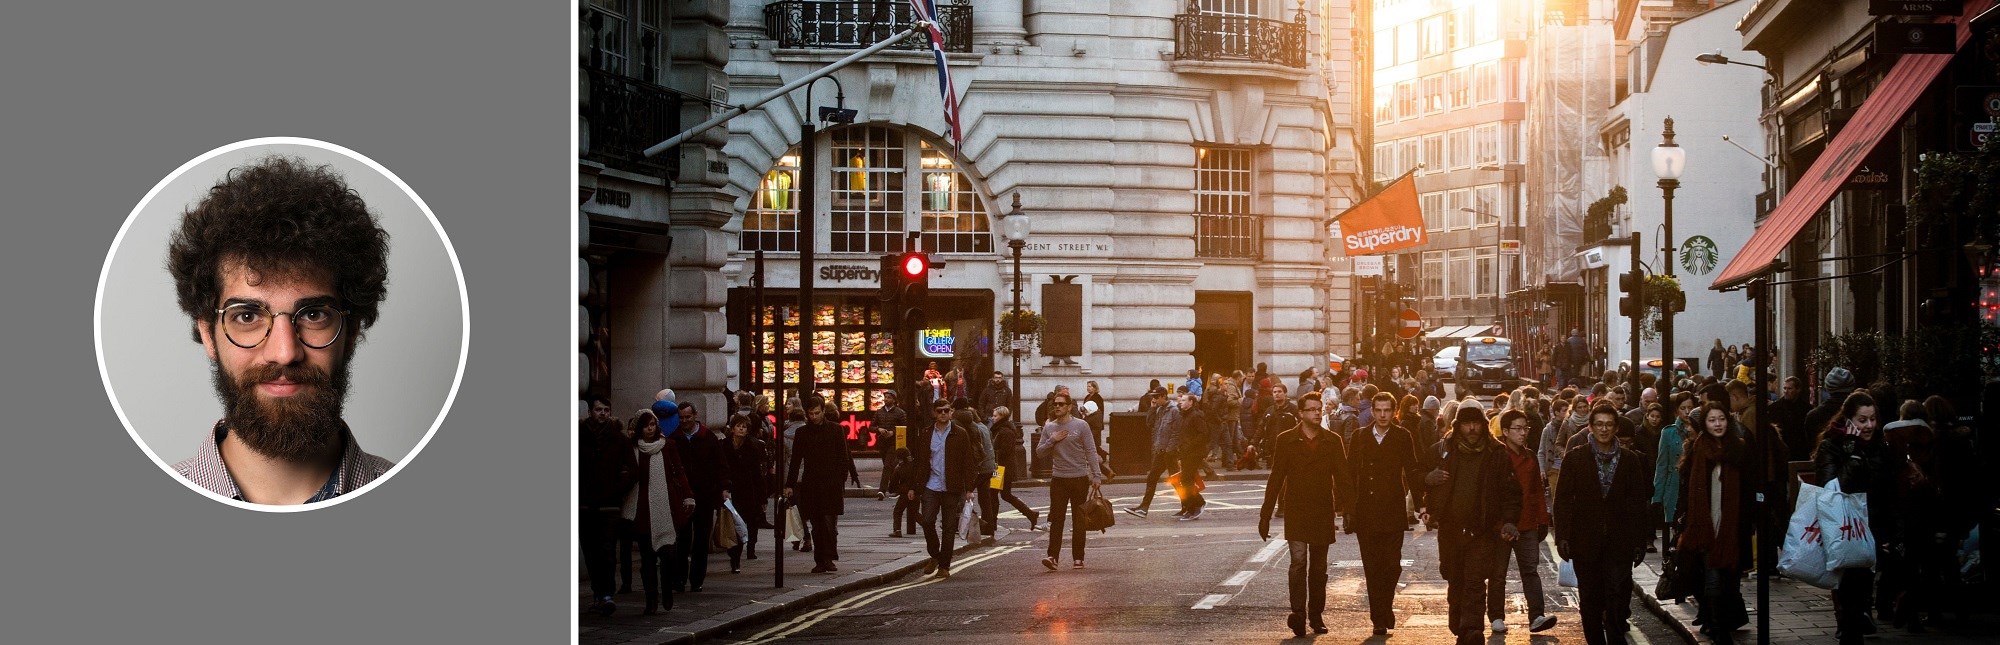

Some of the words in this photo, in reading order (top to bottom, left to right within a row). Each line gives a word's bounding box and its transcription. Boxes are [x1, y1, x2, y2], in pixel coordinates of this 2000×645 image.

[1902, 3, 1933, 11] ARMS
[1022, 243, 1051, 251] GENT
[1058, 243, 1091, 251] STREET
[1345, 225, 1422, 251] Superdry
[820, 265, 881, 283] Superdry
[1800, 518, 1824, 547] H&
[1840, 515, 1868, 542] H&M
